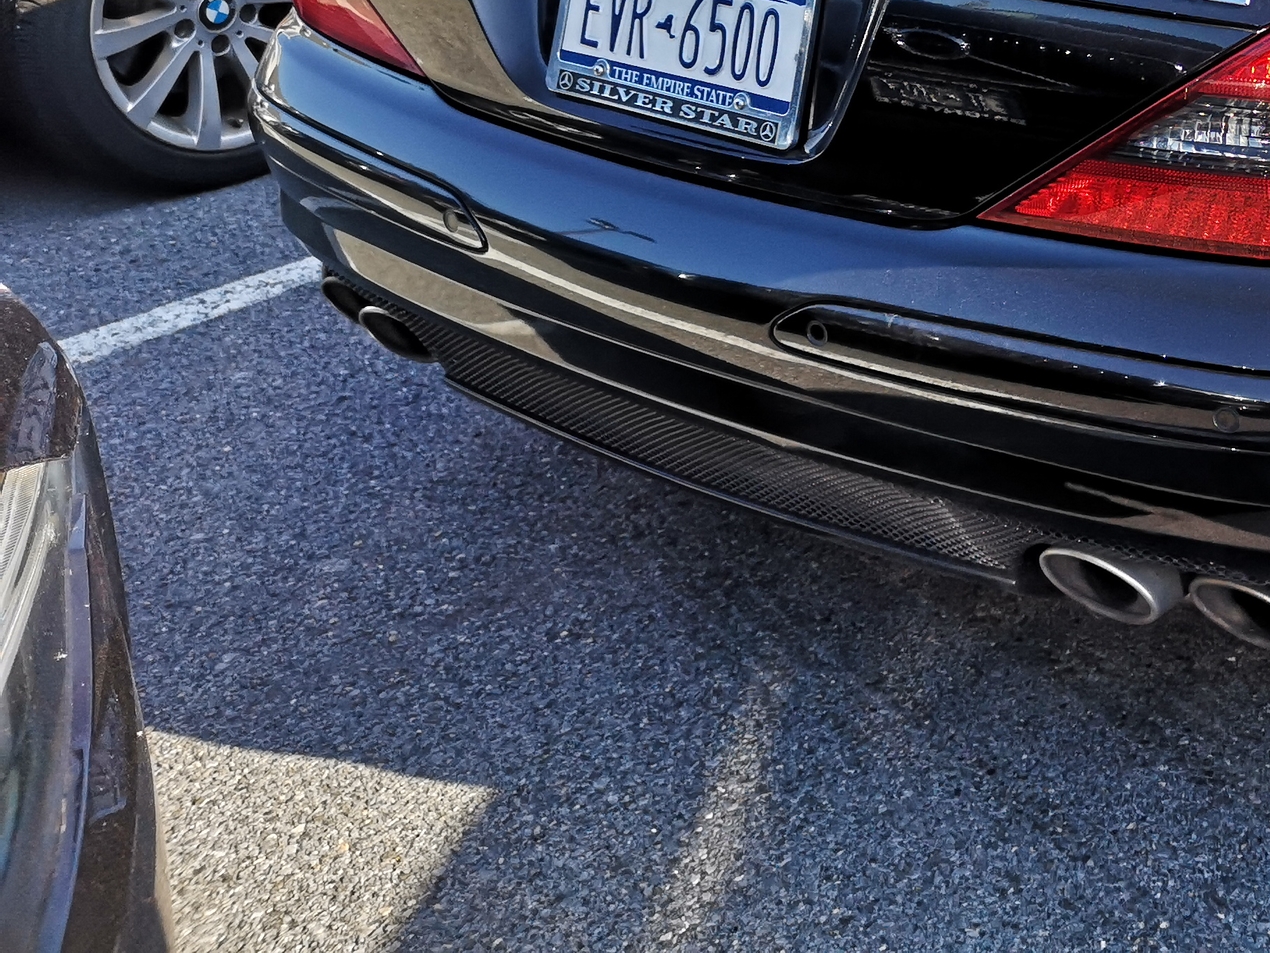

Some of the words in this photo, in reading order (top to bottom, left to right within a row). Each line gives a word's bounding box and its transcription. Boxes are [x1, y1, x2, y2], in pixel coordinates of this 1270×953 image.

[575, 77, 674, 114] SILVER
[678, 103, 758, 136] STAR
[613, 66, 639, 84] THE
[643, 73, 690, 98] EMPIRE
[693, 85, 734, 107] STATE
